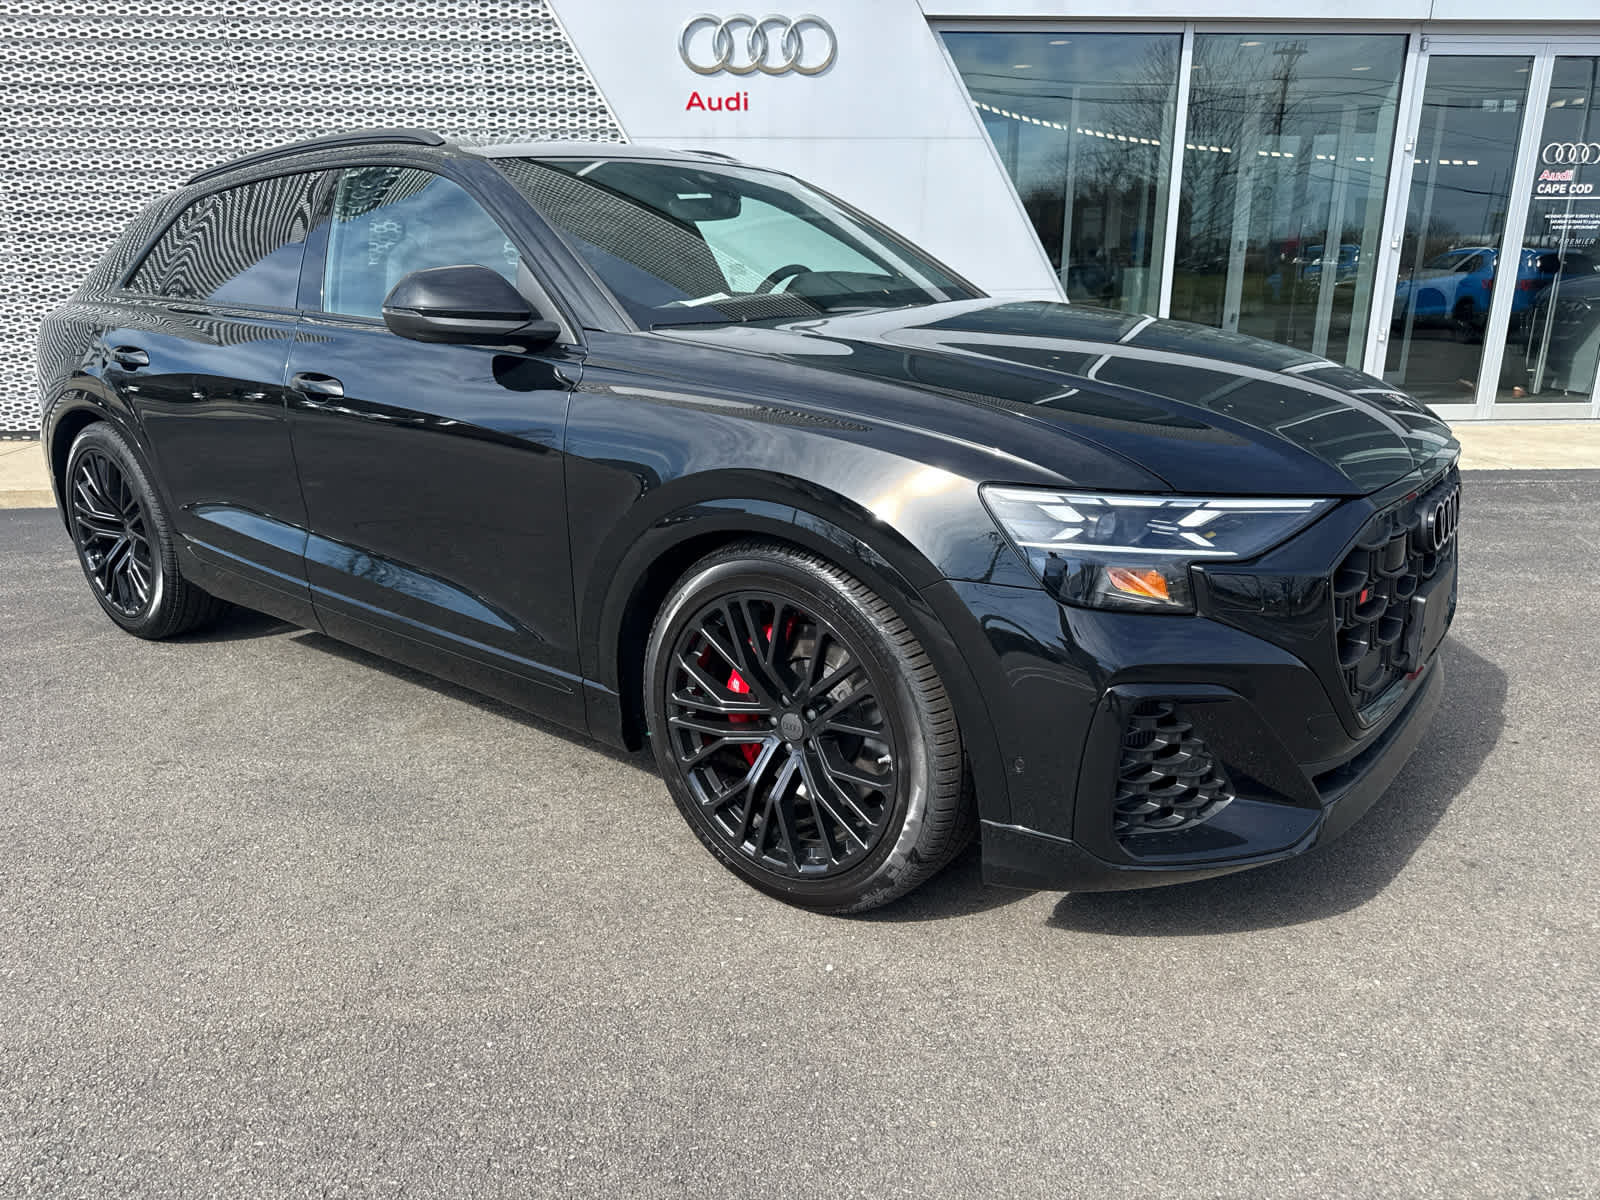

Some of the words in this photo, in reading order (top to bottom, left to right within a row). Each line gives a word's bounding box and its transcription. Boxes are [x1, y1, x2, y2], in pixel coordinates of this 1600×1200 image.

[686, 91, 749, 112] Audi
[1538, 170, 1573, 181] Audi
[1537, 183, 1567, 194] CAPE
[1569, 183, 1593, 194] COD
